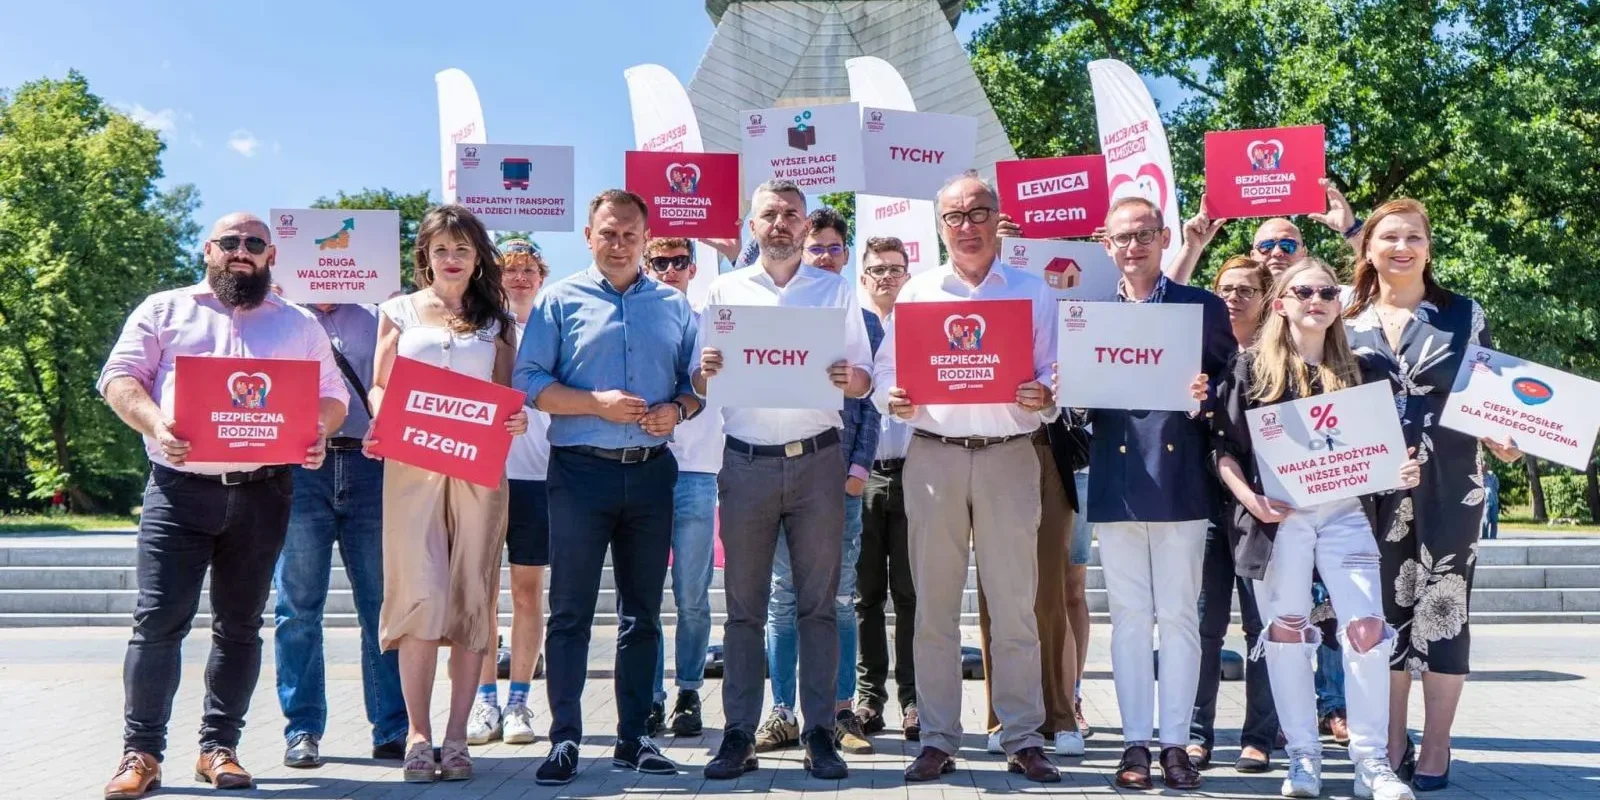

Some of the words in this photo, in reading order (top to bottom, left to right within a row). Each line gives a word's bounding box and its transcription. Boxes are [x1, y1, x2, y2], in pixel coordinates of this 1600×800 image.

[771, 157, 806, 166] WYŻSZE
[808, 154, 837, 164] PŁACE
[889, 146, 945, 164] TYCHY
[775, 170, 784, 178] W
[786, 166, 834, 177] USŁUGACH
[1235, 172, 1297, 185] BEZPIECZNA
[1022, 175, 1085, 197] LEWICA
[1243, 185, 1289, 196] RODZINA
[654, 196, 712, 206] BEZPIECZNA
[485, 207, 512, 215] DZIECI
[519, 207, 565, 216] MŁODZIEŻY
[662, 208, 705, 218] RODZINA
[1024, 207, 1087, 223] razem
[318, 258, 356, 267] DRUGA
[297, 270, 378, 279] WALORYZACJA
[310, 282, 365, 290] EMERYTUR
[743, 348, 809, 366] TYCHY
[930, 354, 1000, 366] BEZPIECZNA
[1095, 346, 1164, 365] TYCHY
[940, 368, 992, 380] RODZINA
[412, 394, 490, 421] LEWICA
[211, 411, 285, 423] BEZPIECZNA
[1483, 400, 1518, 417] CIEPŁY
[1520, 411, 1564, 432] POSIŁEK
[220, 426, 275, 438] RODZINA
[1460, 405, 1482, 417] DLA
[1484, 412, 1537, 434] KAŻDEGO
[1539, 428, 1578, 448] UCZNIA
[402, 425, 479, 461] razem
[1277, 459, 1317, 475] WALKA
[1319, 456, 1327, 466] Z
[1328, 443, 1389, 464] DROŻYZNĄ
[1305, 469, 1341, 483] NIŻSZE
[1343, 461, 1371, 475] RATY
[1307, 474, 1368, 494] KREDYTÓW
